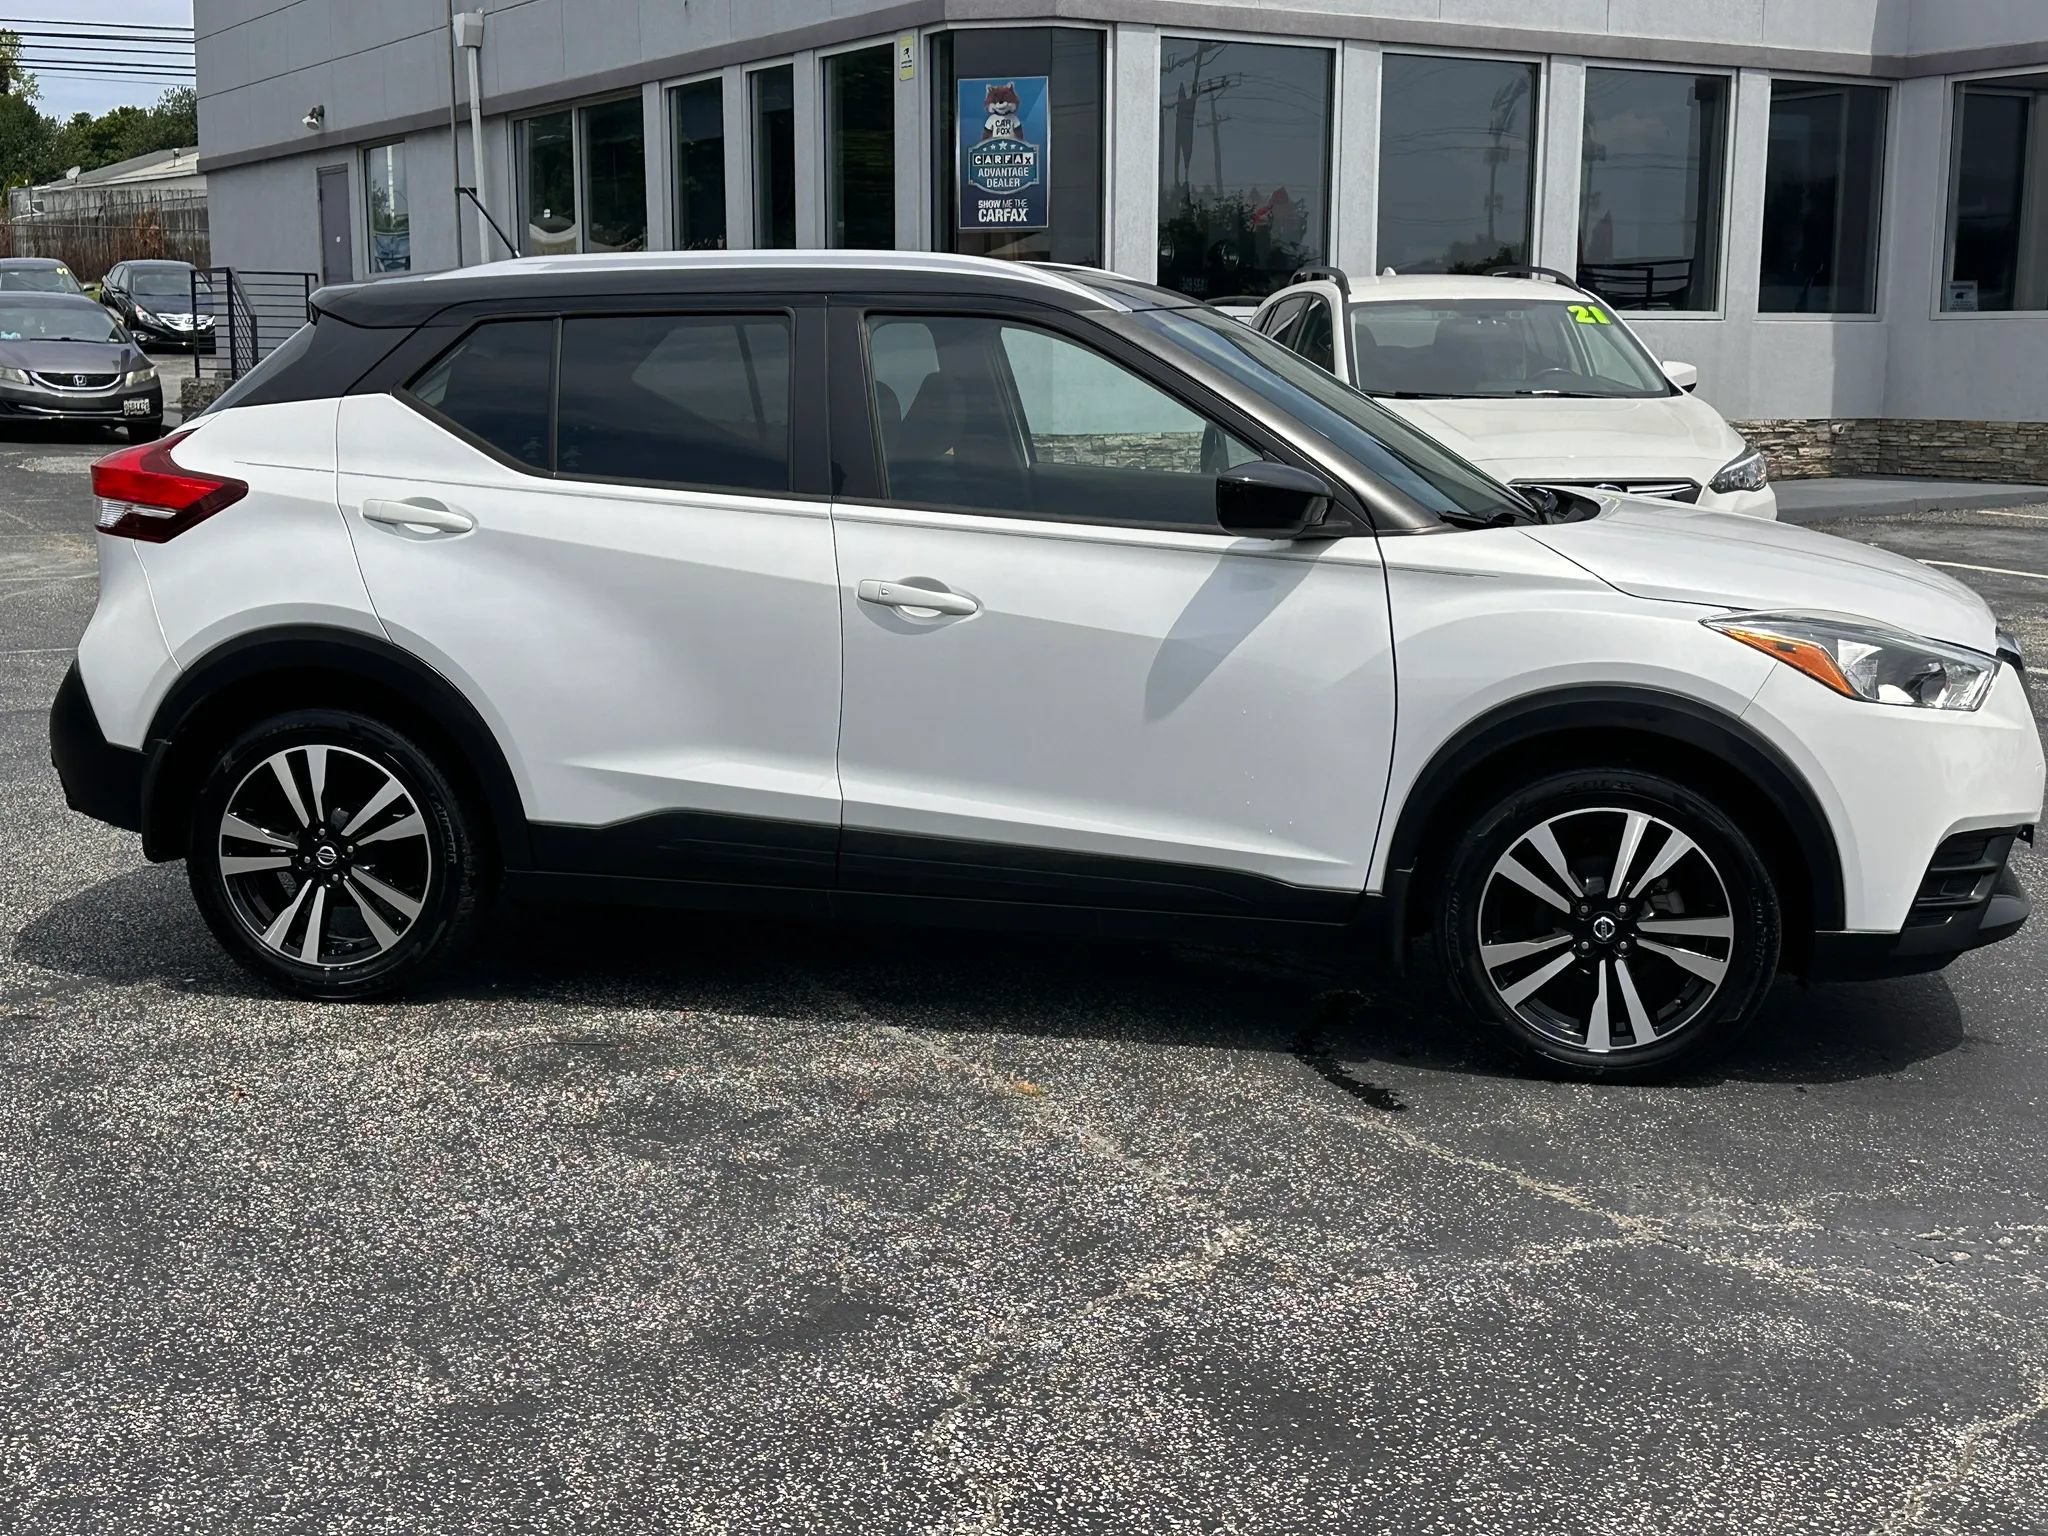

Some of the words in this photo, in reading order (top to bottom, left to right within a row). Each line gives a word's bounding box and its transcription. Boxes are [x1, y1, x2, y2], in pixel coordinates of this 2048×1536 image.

[995, 119, 1011, 128] CAR
[974, 153, 1032, 165] CARFAX
[978, 167, 1029, 177] ADVANTAGE
[986, 178, 1020, 188] DEALER
[978, 199, 1001, 208] SHOW
[1002, 199, 1012, 208] ME
[1014, 198, 1027, 207] THE
[978, 208, 1029, 222] CARFAX
[1567, 304, 1611, 325] 21
